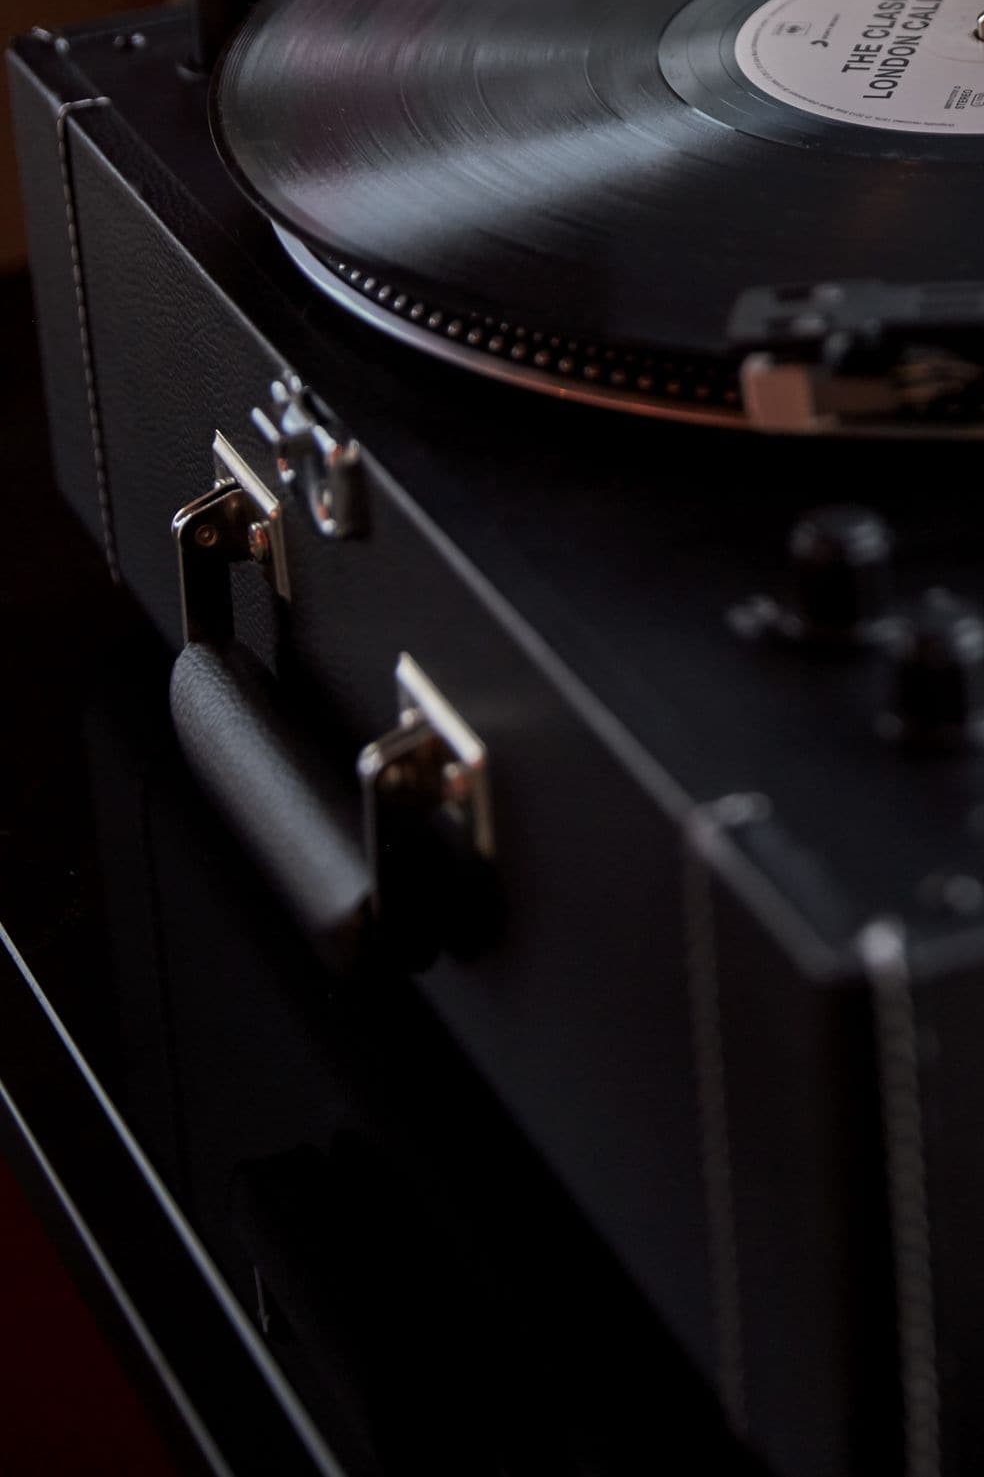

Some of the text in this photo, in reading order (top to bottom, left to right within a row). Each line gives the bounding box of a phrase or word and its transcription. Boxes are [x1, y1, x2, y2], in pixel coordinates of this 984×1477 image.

[841, 44, 883, 73] THE
[862, 35, 922, 99] LONDON
[954, 89, 973, 109] STEREO
